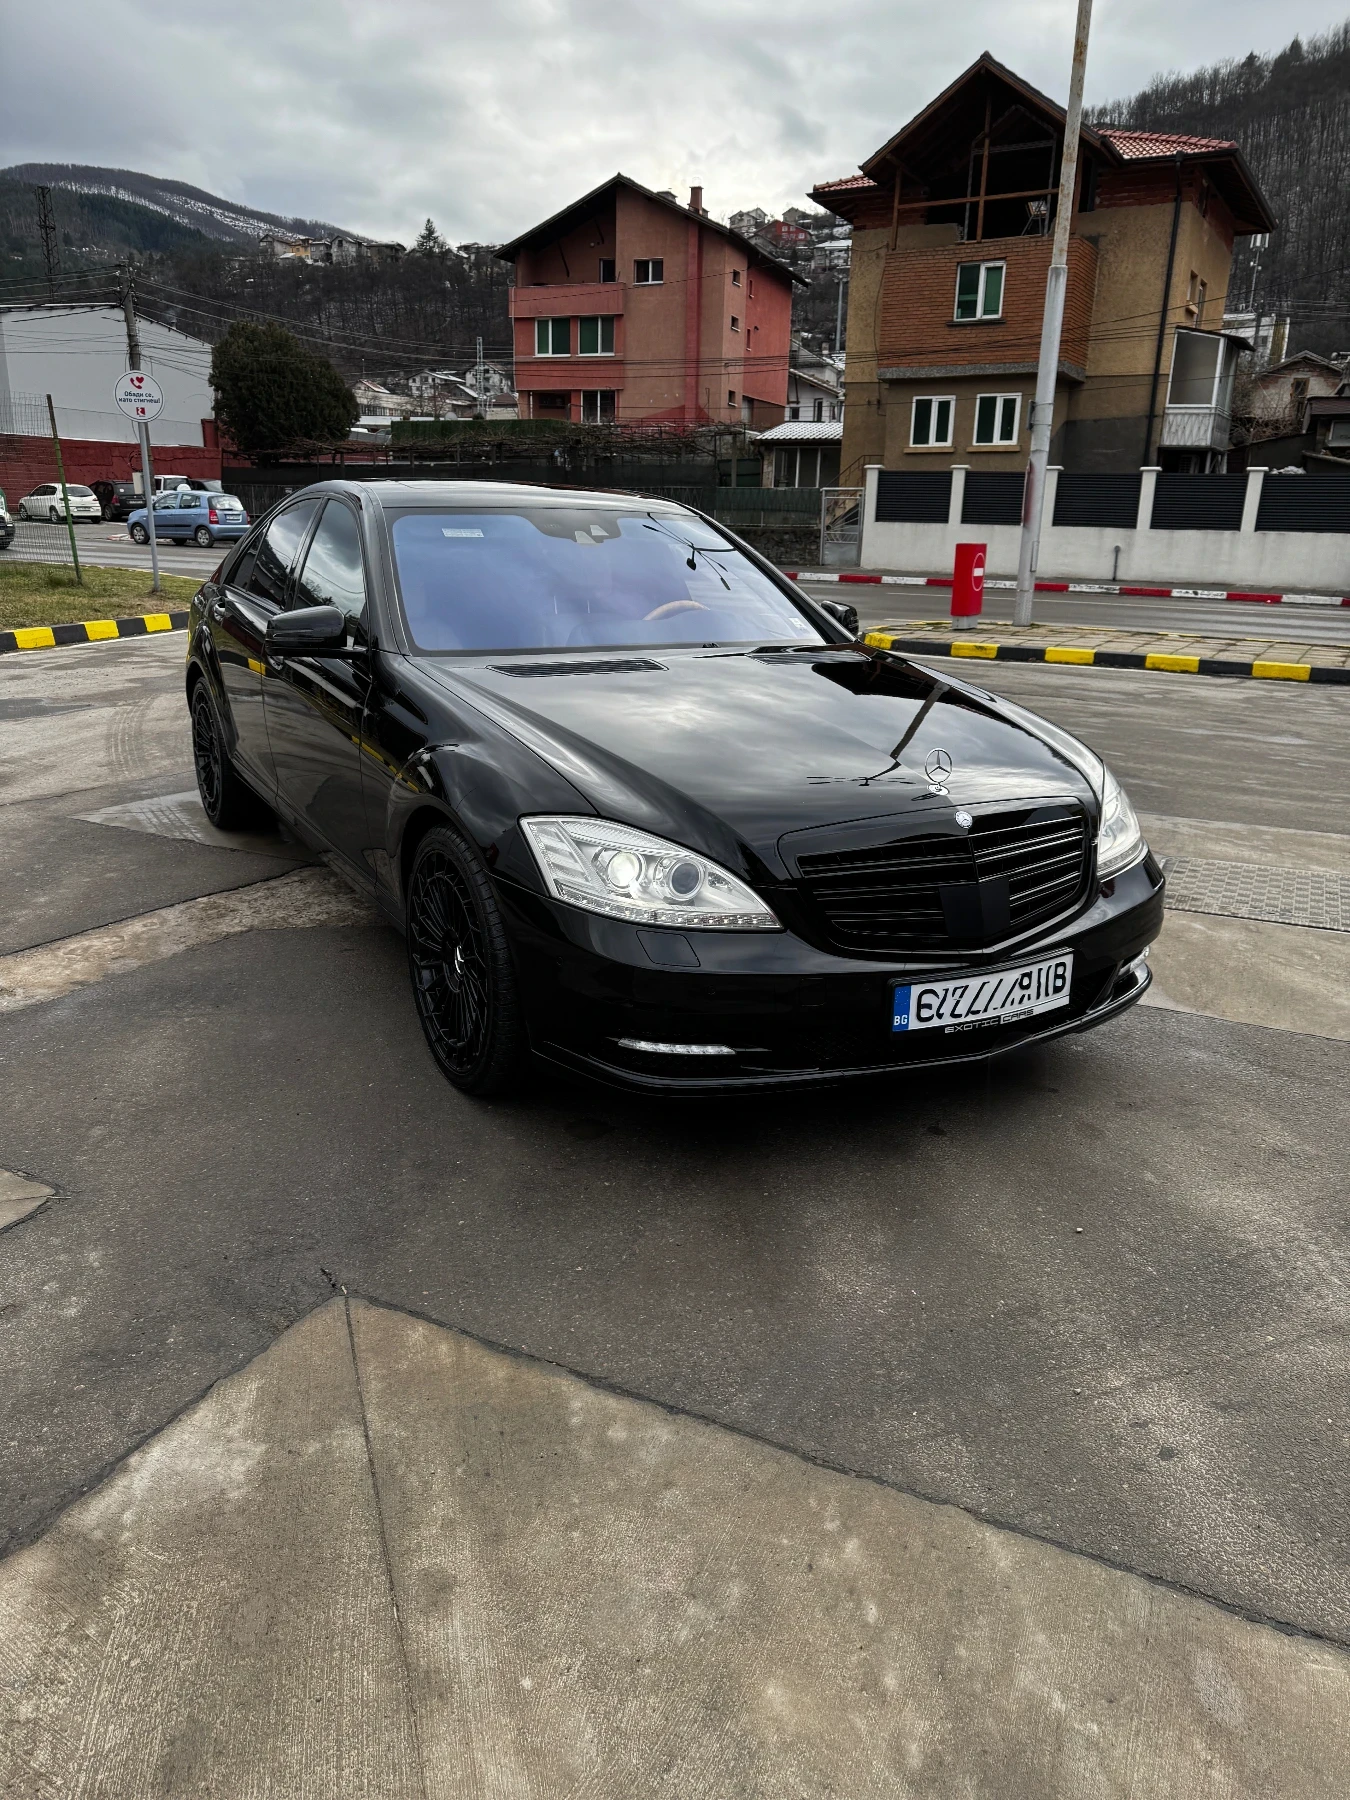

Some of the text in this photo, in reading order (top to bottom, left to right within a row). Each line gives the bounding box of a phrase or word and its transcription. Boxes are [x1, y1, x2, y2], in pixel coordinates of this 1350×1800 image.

[124, 390, 144, 398] Обади
[893, 1014, 908, 1026] BG
[944, 1008, 1034, 1034] EXOTIC CARS
